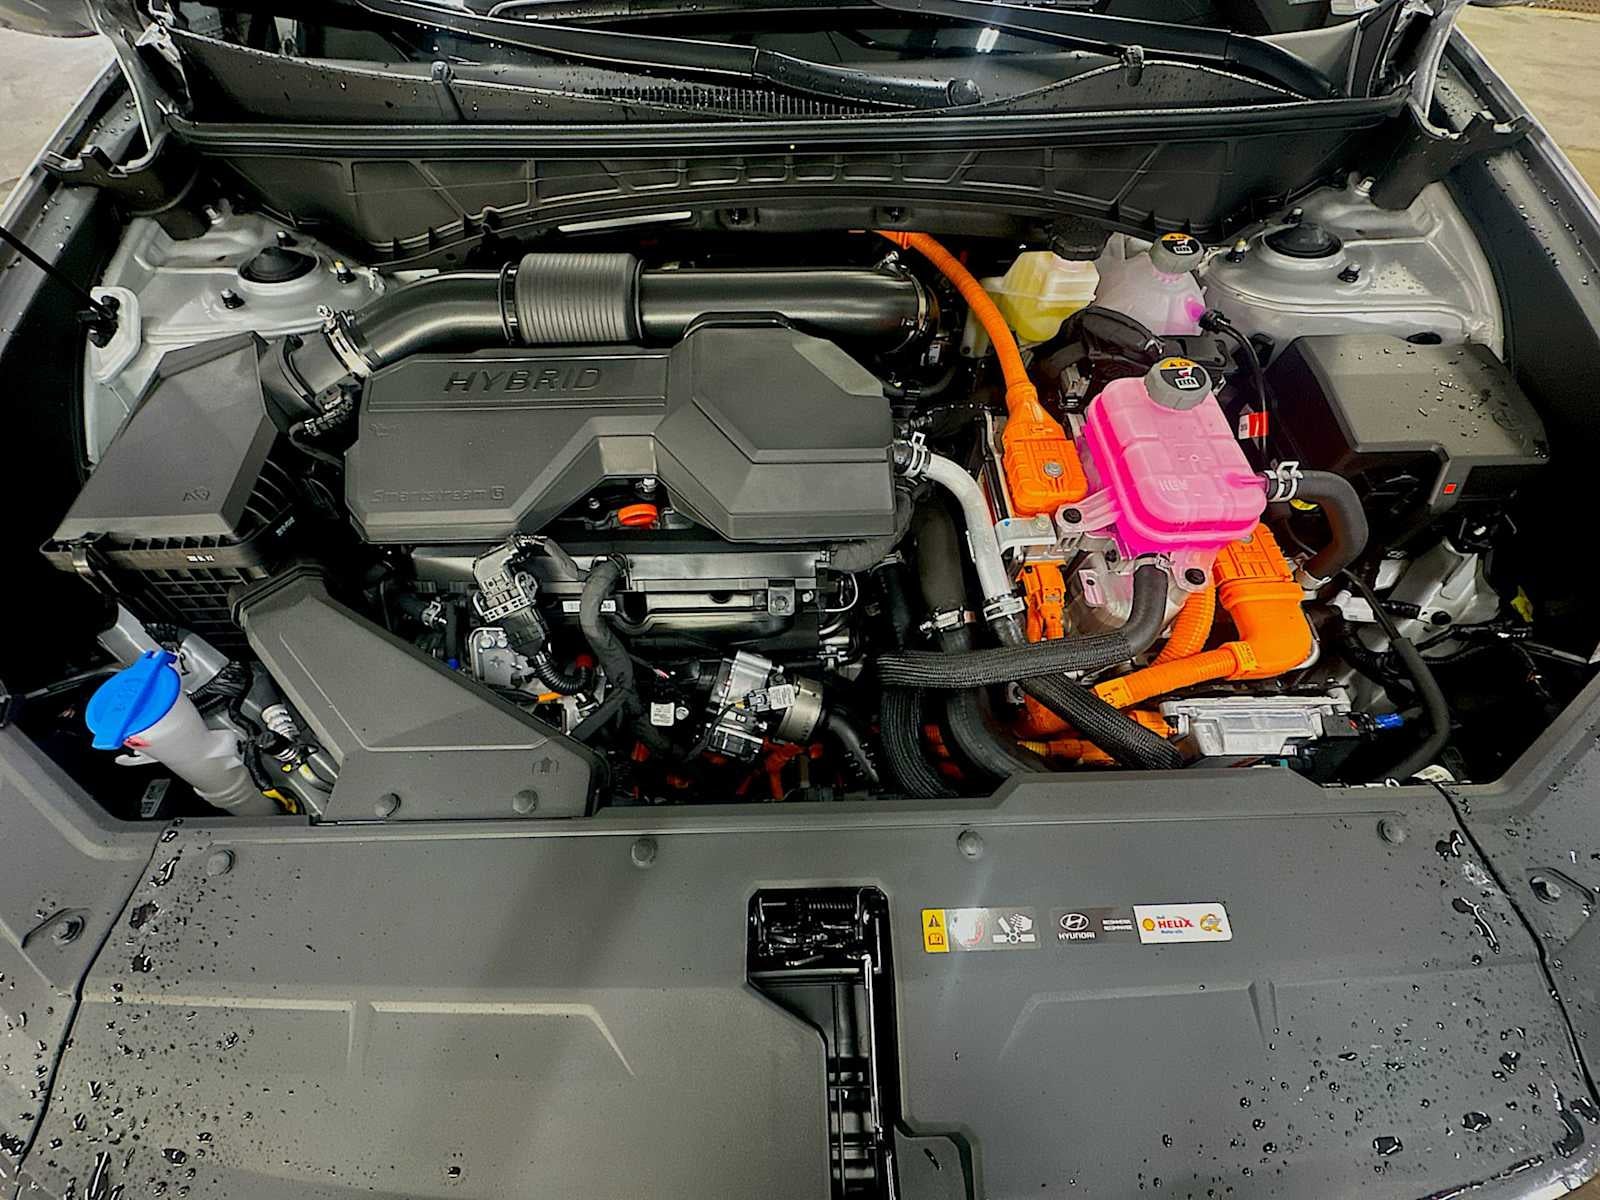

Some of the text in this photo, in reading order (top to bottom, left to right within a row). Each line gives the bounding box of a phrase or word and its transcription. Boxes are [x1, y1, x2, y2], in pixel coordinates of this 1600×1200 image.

[443, 368, 601, 393] HYBRID
[1158, 917, 1195, 929] HELIX
[1058, 931, 1096, 941] HYUNDAI
